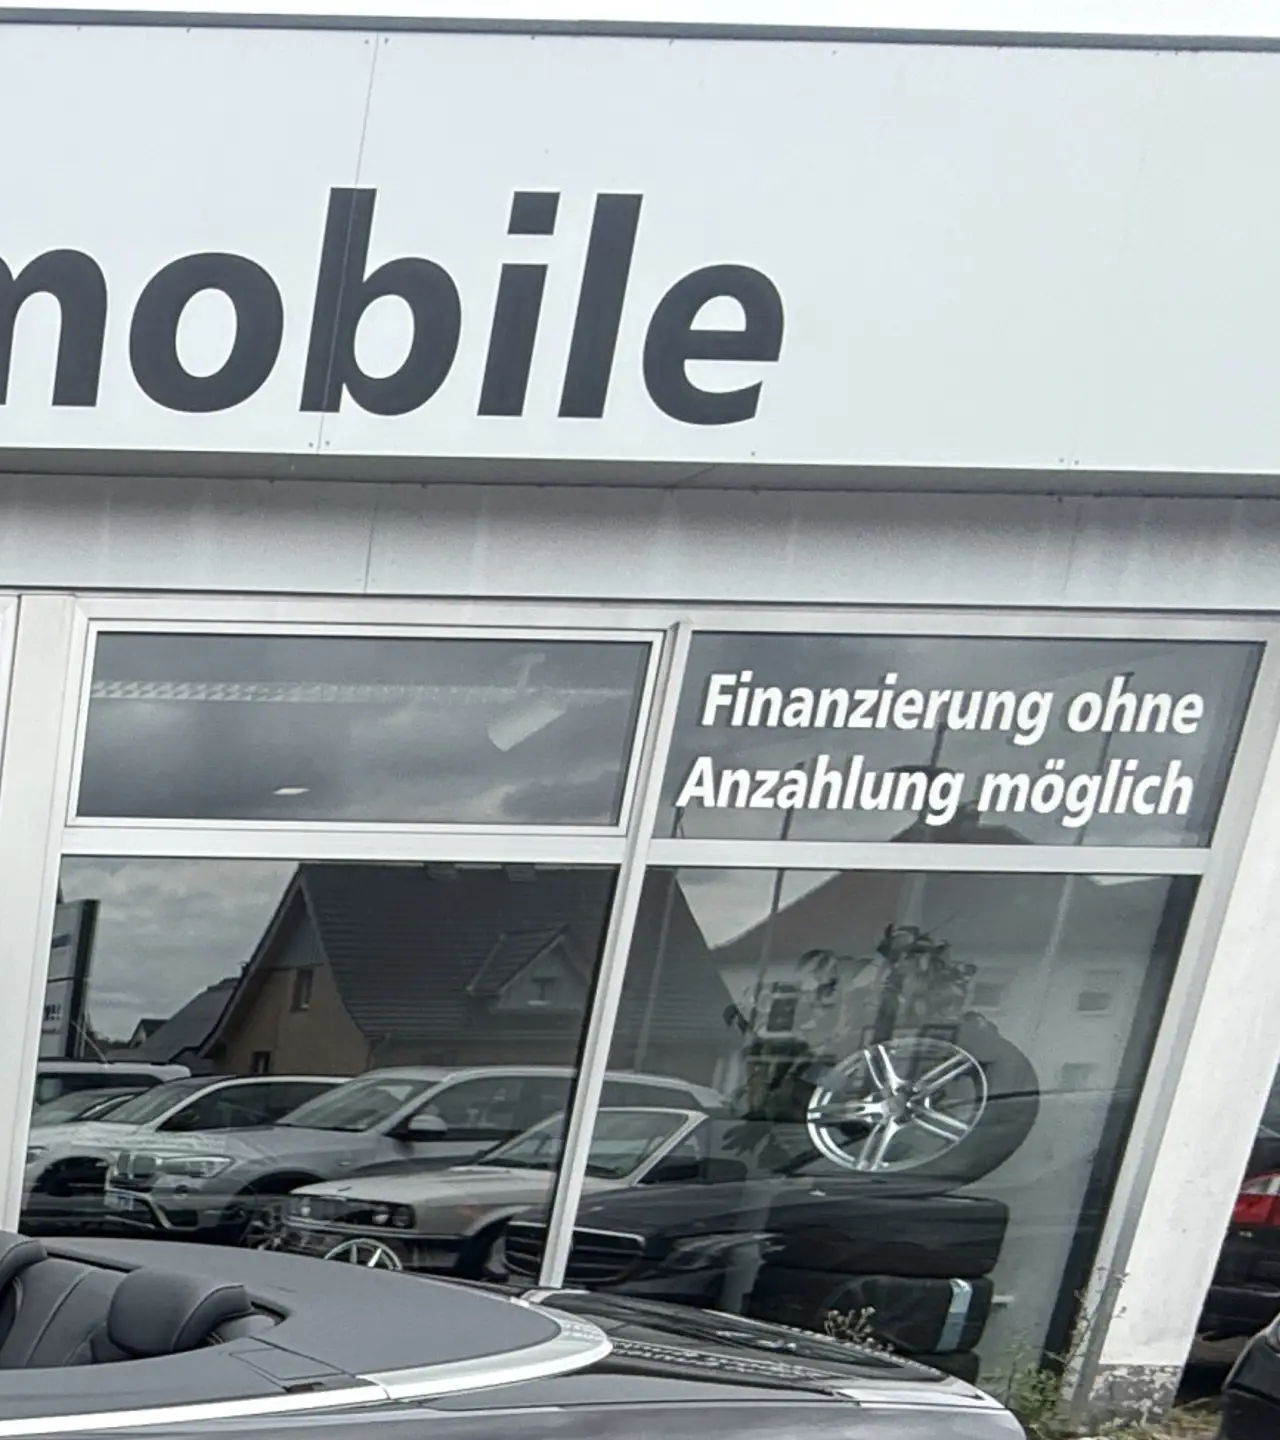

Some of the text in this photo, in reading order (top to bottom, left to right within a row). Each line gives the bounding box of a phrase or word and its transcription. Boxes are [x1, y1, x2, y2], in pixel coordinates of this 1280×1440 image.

[702, 670, 1204, 746] Finanzierung ohne
[675, 755, 1194, 828] Anzahlung möglich
